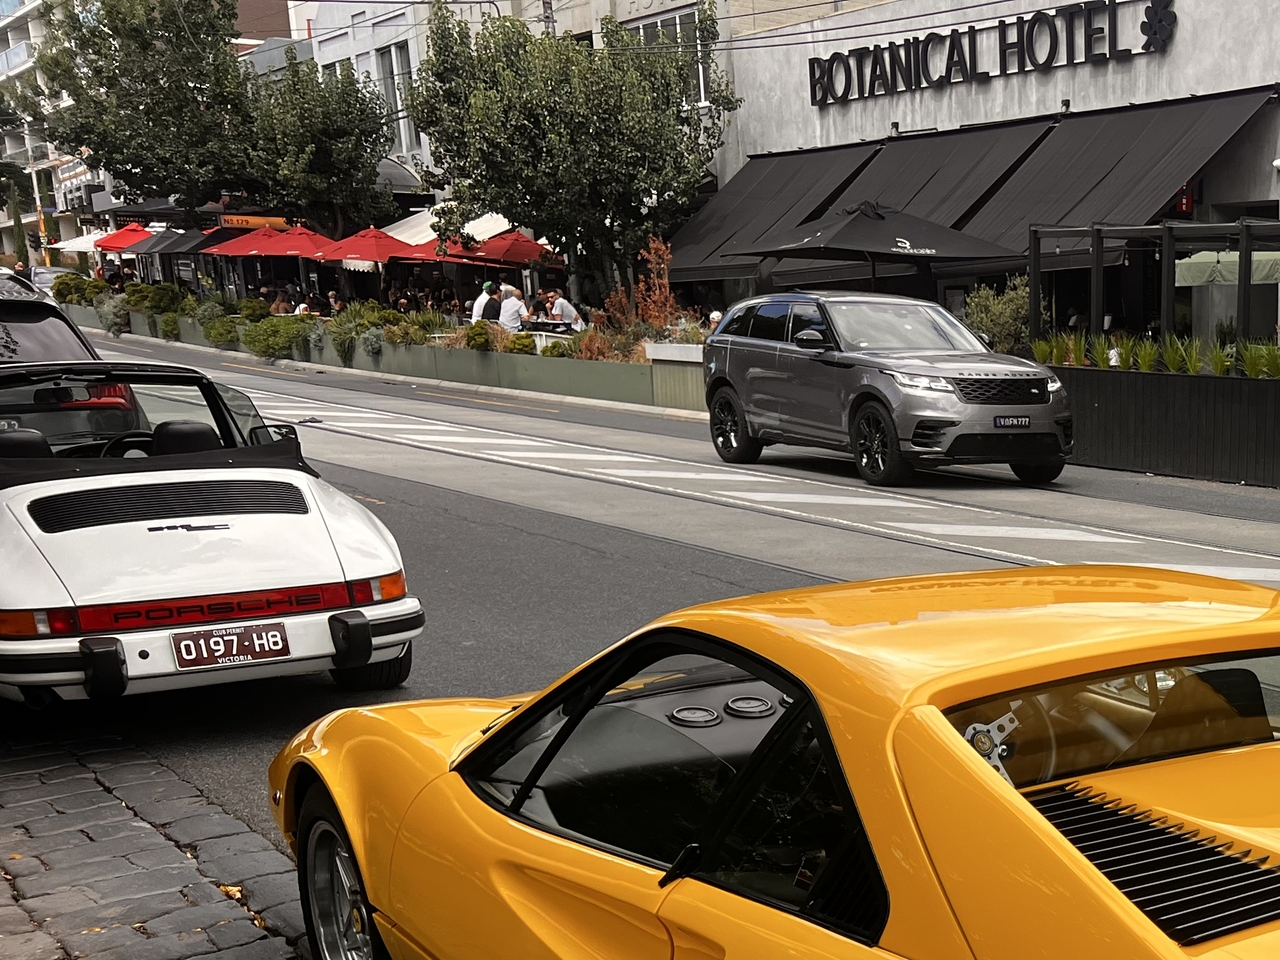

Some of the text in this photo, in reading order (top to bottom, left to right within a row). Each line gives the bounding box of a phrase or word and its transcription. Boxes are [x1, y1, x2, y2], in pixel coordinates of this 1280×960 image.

[808, 0, 1134, 107] BOTANICAL HOTEL
[113, 593, 322, 624] PORSCHE
[212, 627, 245, 637] CLUB PERMIT
[217, 654, 253, 664] VICTORIA
